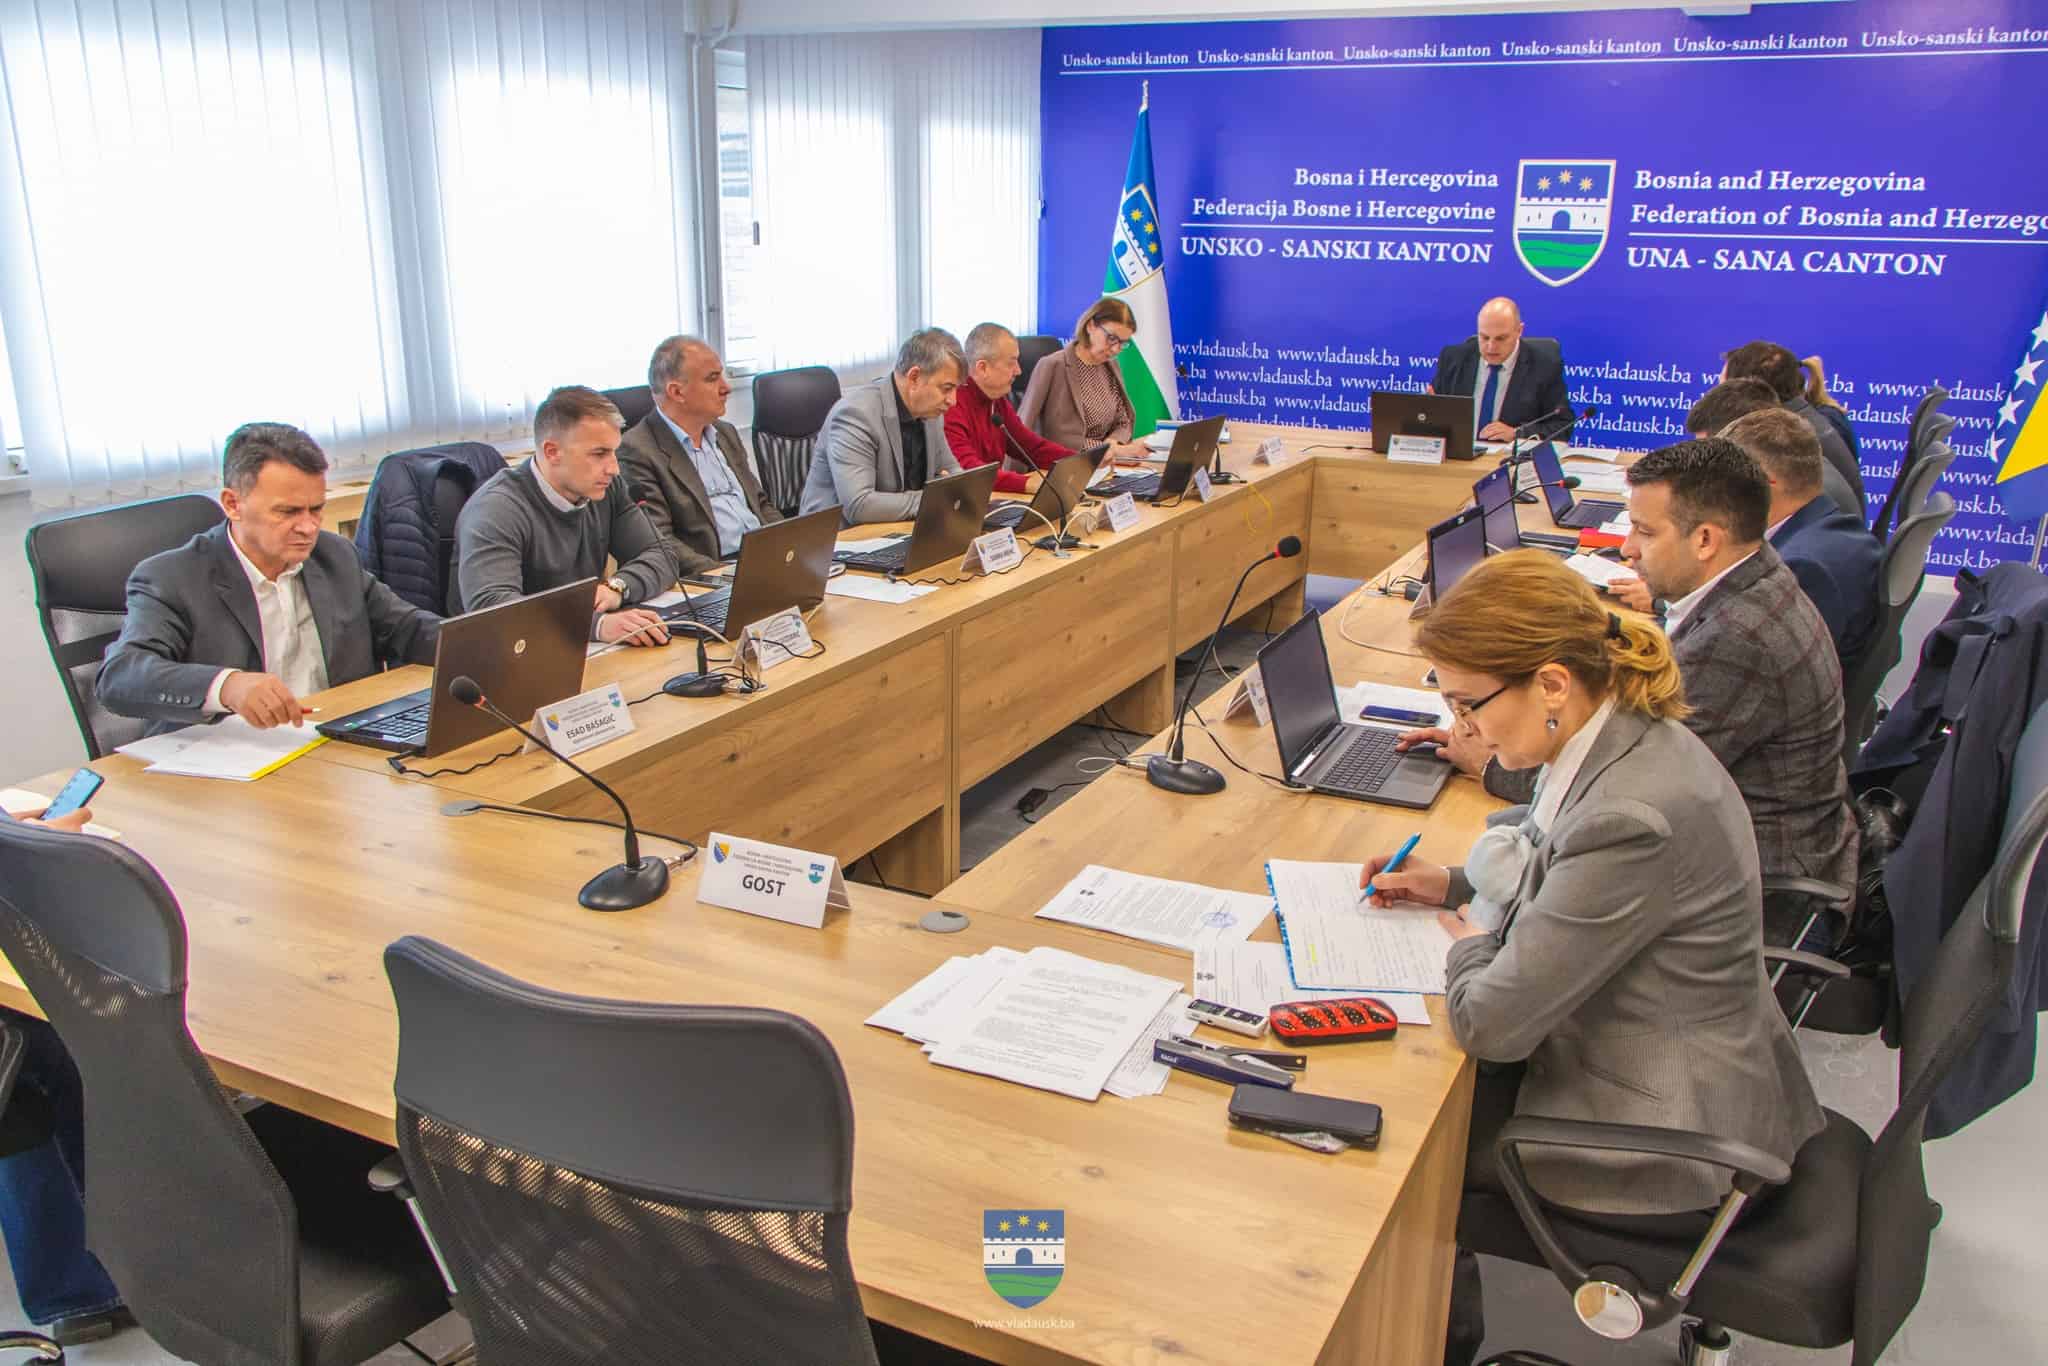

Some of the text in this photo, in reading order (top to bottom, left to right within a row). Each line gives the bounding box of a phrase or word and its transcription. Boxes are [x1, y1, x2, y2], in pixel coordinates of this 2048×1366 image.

[1063, 51, 1142, 67] Unsko-sanski
[1145, 51, 1189, 65] kanton
[1198, 48, 1283, 64] Unsko-sanski
[1287, 47, 1334, 61] kanton
[1343, 43, 1437, 60] Unsko-sanski
[1440, 42, 1491, 57] kanton
[1501, 39, 1603, 56] Unsko-sanski
[1607, 38, 1662, 54] kanton
[1673, 35, 1785, 52] Unsko-sanski
[1788, 33, 1848, 49] kanton
[1861, 28, 1984, 47] Unsko-sanski
[1294, 168, 1499, 193] Bosna i Hercegovina
[1633, 170, 1926, 197] Bosnia and Herzegovina
[1192, 198, 1496, 225] Federacija Bosne i Hercegovine
[1629, 204, 2048, 236] Federation of Bosnia and Herzego
[1180, 237, 1263, 257] UNSKO
[1281, 239, 1372, 260] SANSKI
[1375, 241, 1493, 263] KANTON
[1626, 246, 1691, 269] UNA
[1713, 248, 1796, 272] SANA
[1802, 250, 1946, 276] CANTON
[1173, 339, 1270, 360] w.vladausk.ba
[1276, 345, 1400, 367] www.vladausk.ba
[1214, 366, 1333, 387] www.vladausk.ba
[1563, 360, 1691, 384] ww.vladausk.ba
[742, 874, 786, 897] GOST
